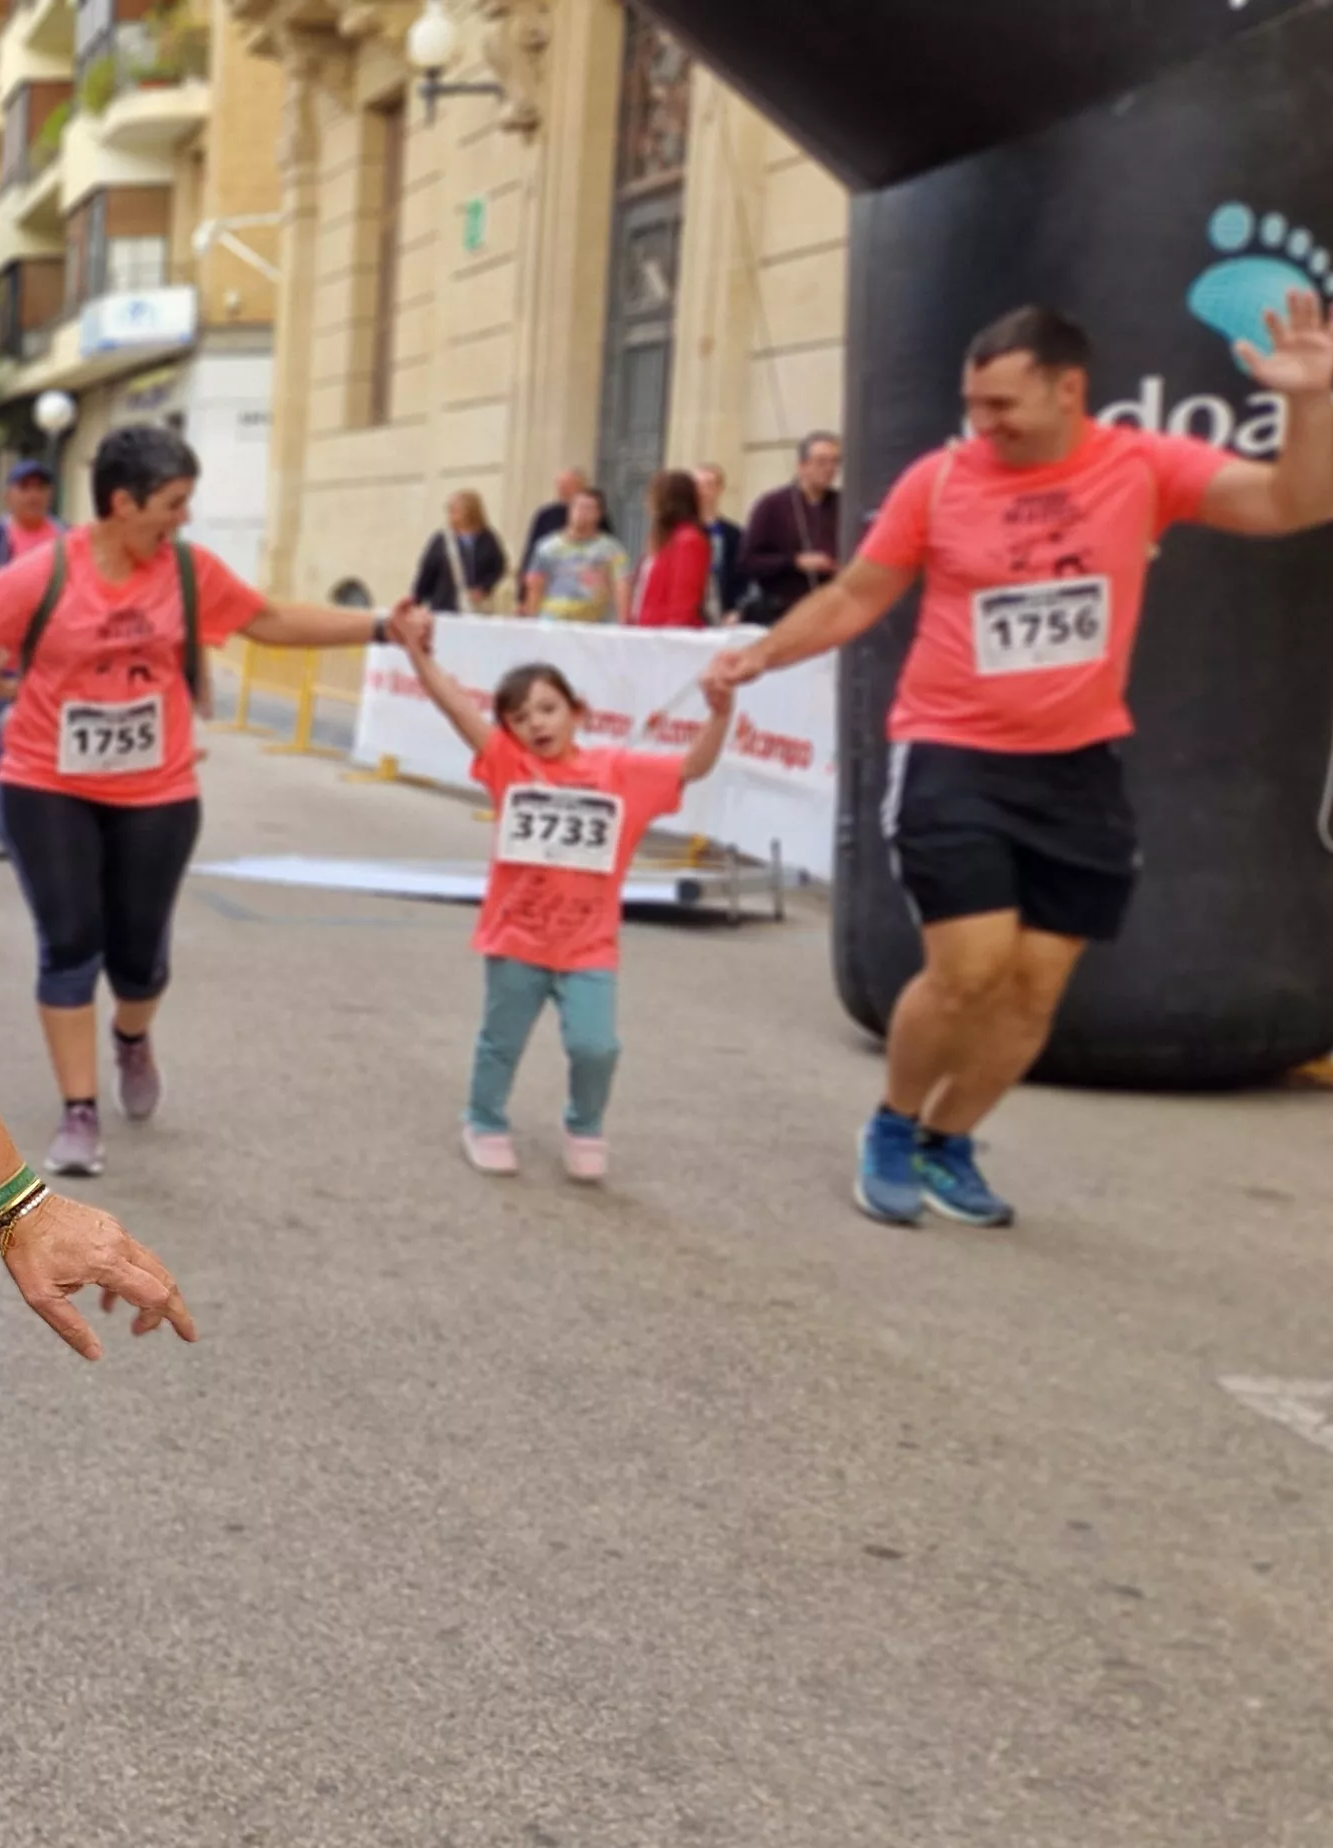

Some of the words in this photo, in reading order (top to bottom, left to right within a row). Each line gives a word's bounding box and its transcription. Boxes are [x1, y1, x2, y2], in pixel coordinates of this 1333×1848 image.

[991, 605, 1100, 650] 1756
[73, 722, 155, 755] 1755
[511, 811, 608, 848] 3733
